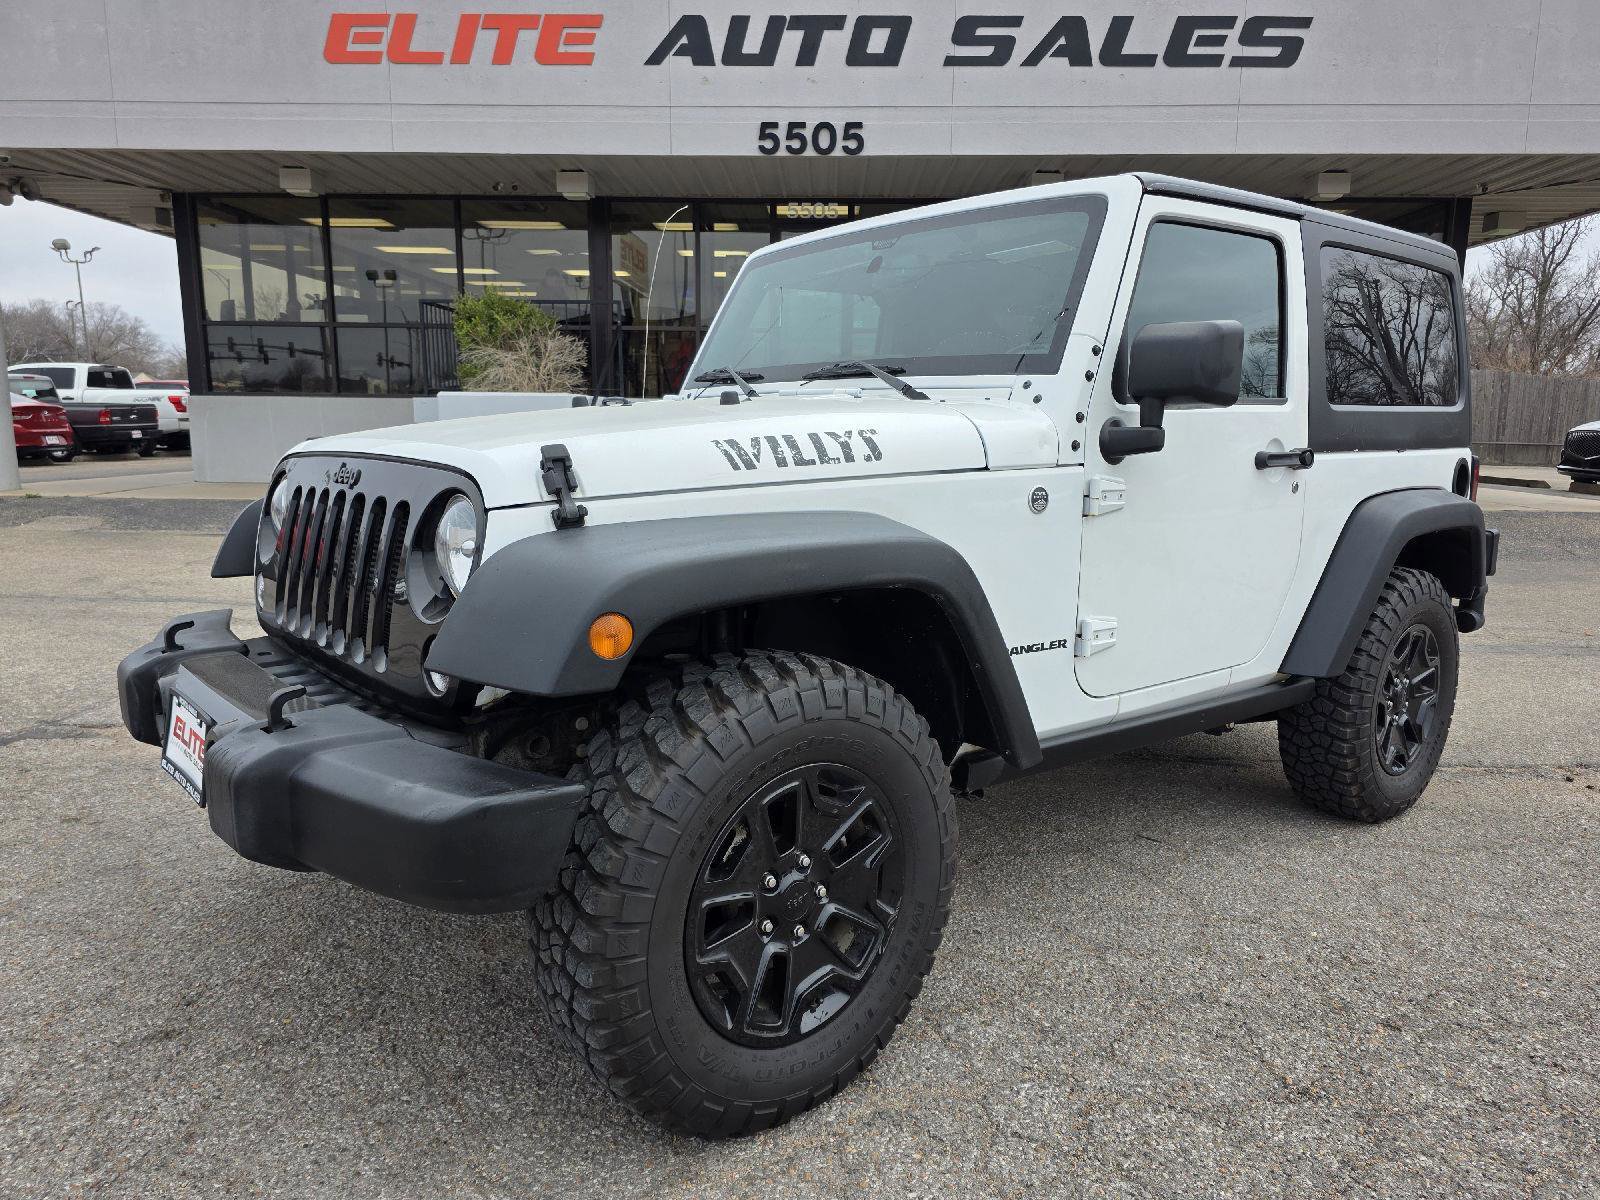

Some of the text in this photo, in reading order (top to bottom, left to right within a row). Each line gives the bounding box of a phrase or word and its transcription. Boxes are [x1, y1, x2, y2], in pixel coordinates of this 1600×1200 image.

[323, 13, 1314, 69] ELITE AUTO SALES
[757, 121, 865, 155] 5505
[786, 202, 839, 219] 5505
[710, 428, 883, 472] WILLYS
[1008, 638, 1068, 657] ANGLER
